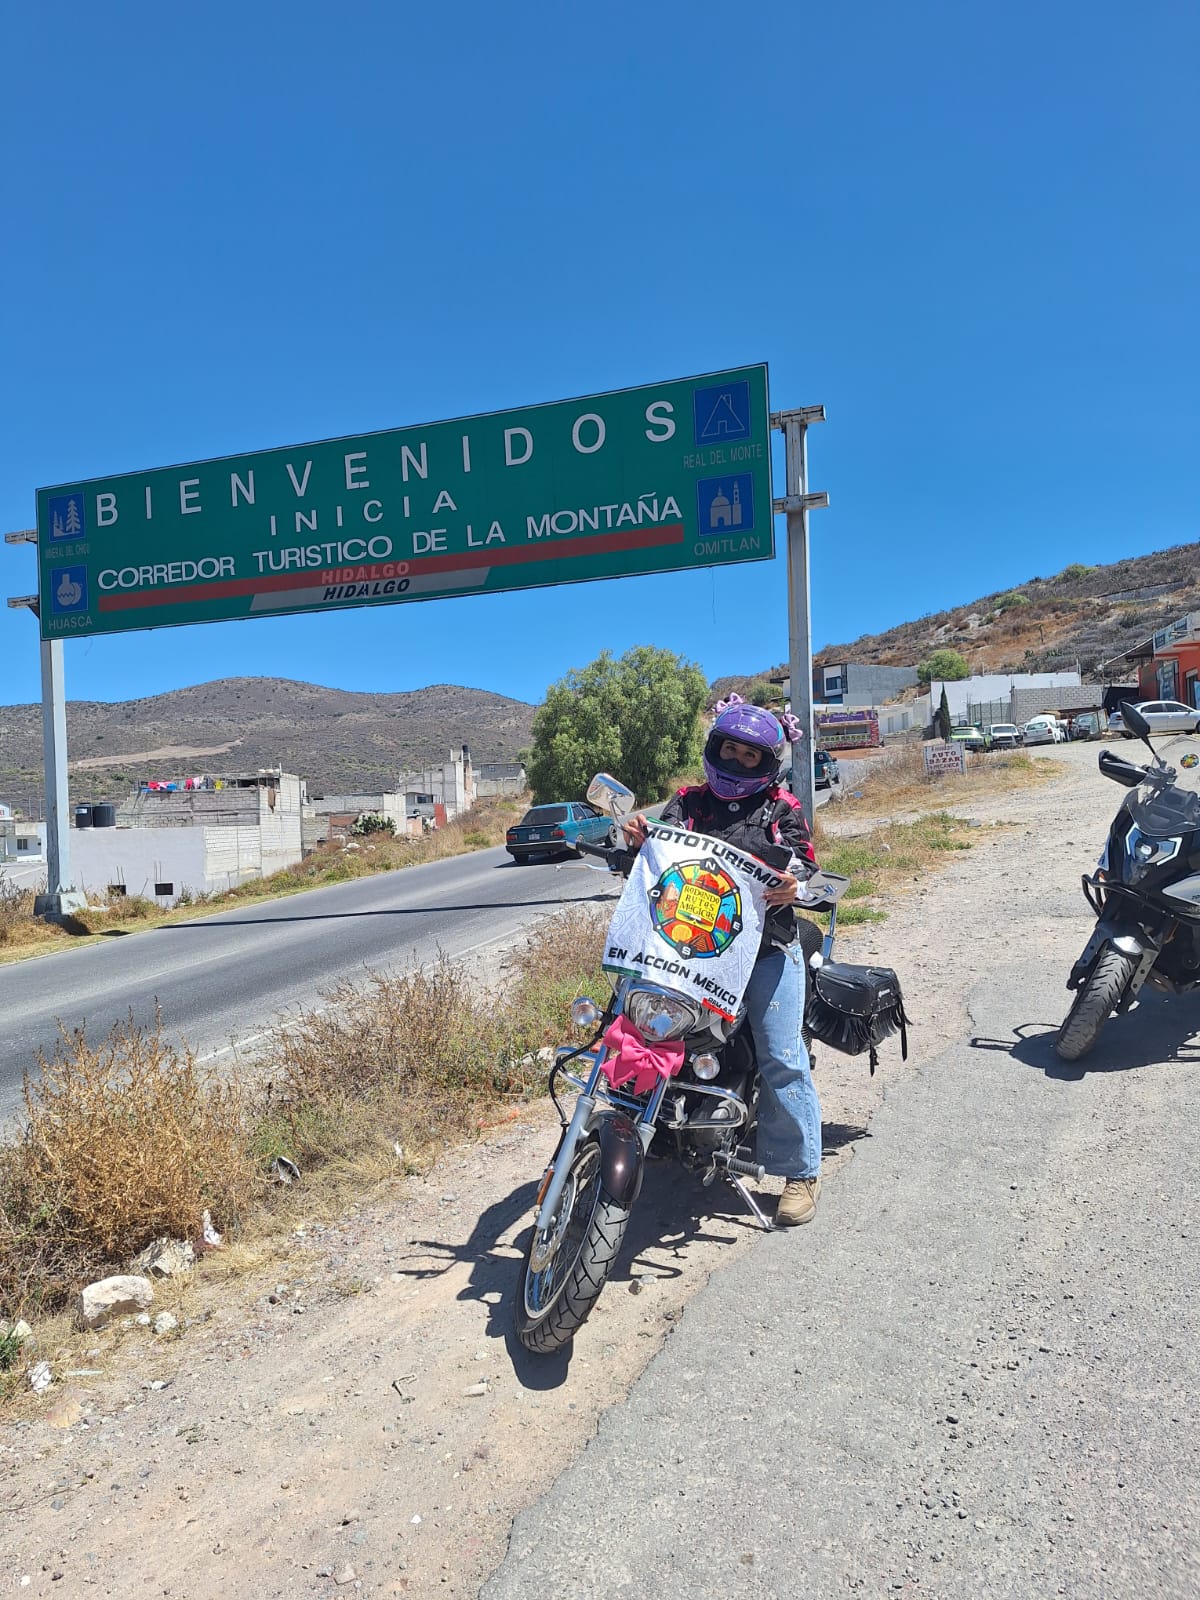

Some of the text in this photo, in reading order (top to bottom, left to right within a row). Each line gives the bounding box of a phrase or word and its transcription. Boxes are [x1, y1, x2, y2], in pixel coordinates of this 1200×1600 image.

[96, 400, 677, 527] BIENVENIDOS
[683, 444, 763, 470] REAL DEL MONTE
[270, 490, 457, 536] INICIA
[97, 491, 683, 590] CORREDOR TURISTICO DE LA MONTAÑA
[694, 535, 761, 557] OMITLAN
[321, 561, 410, 585] HIDALGO
[323, 578, 411, 601] HIDALGO
[48, 616, 93, 631] HUASCA
[705, 861, 717, 871] N
[732, 922, 741, 932] E
[682, 947, 692, 957] S
[608, 947, 738, 1006] EN ACCIÓN MÉXICO
